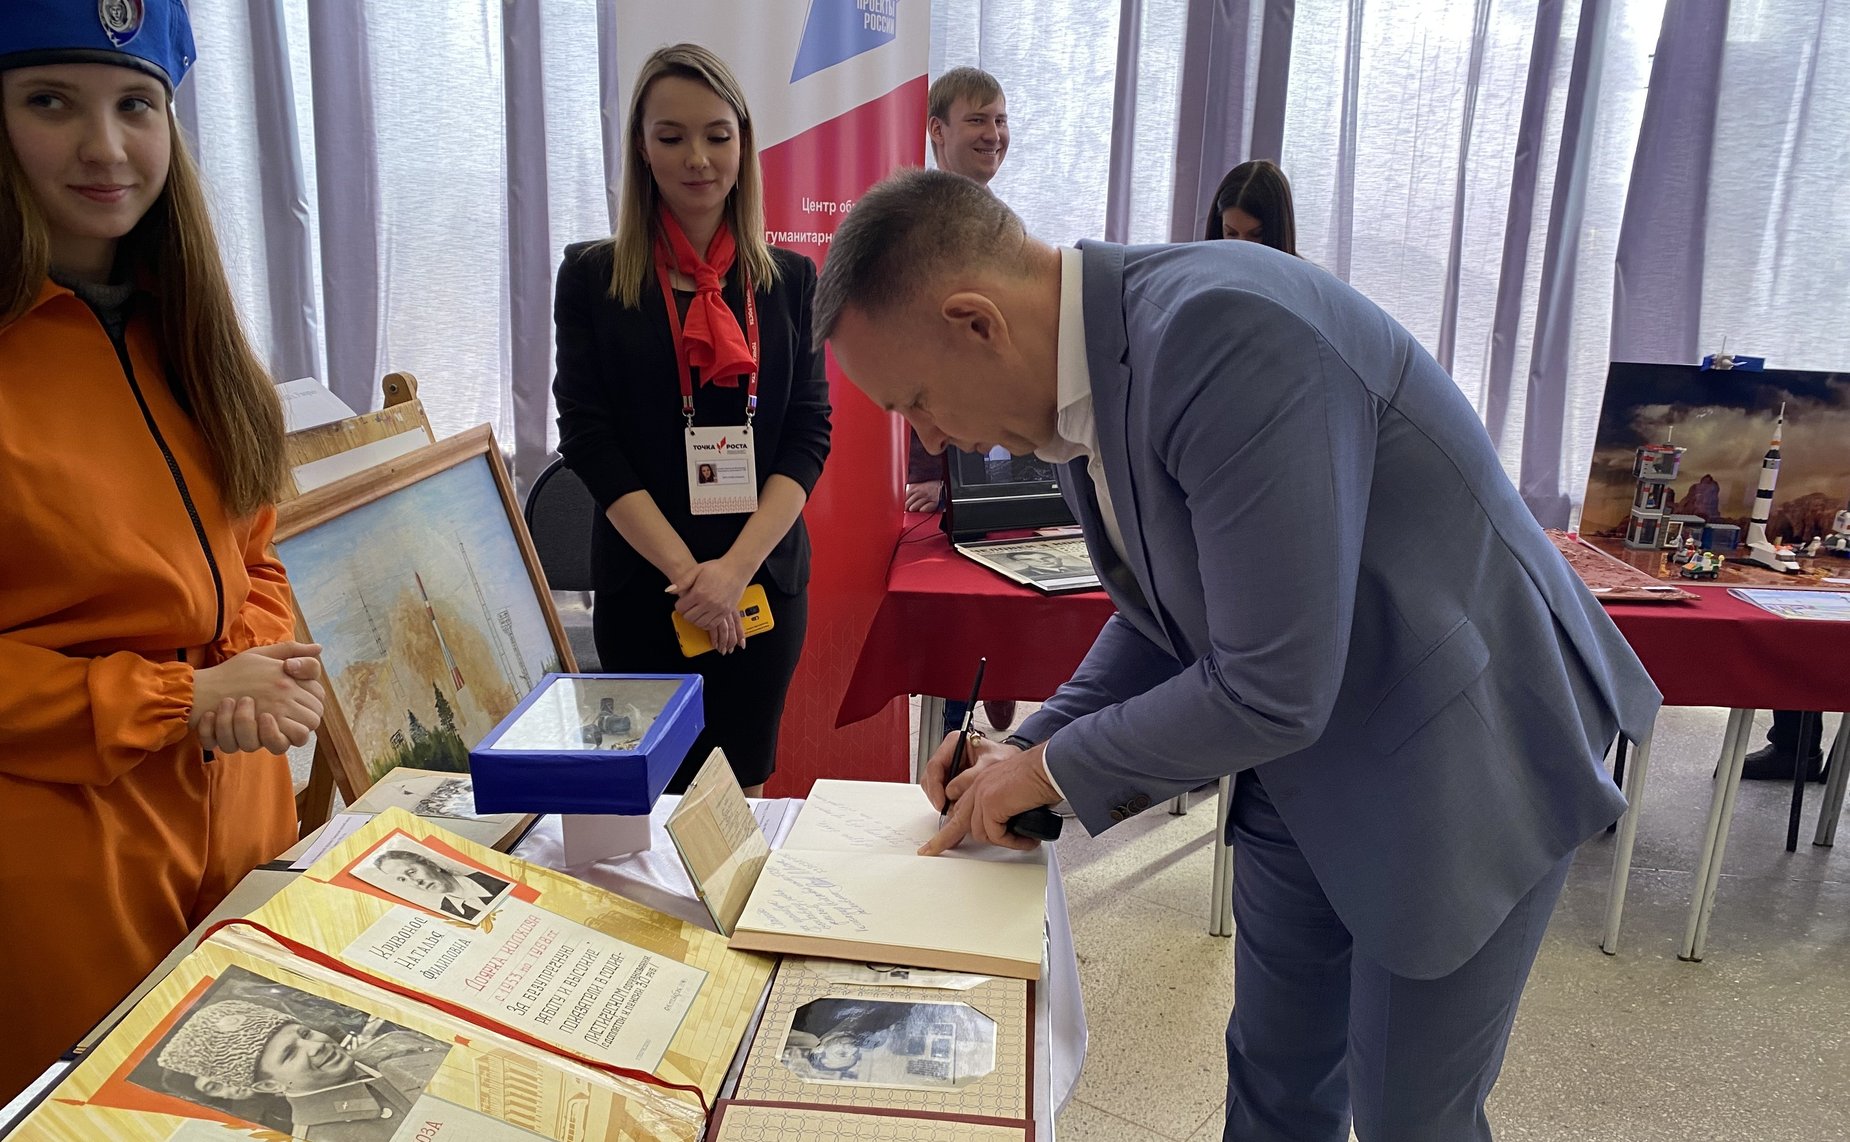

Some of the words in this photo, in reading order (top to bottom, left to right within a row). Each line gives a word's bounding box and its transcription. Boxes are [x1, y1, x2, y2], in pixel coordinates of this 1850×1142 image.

[864, 12, 895, 35] РОССИИ
[802, 197, 837, 216] Центр
[840, 200, 857, 213] об
[765, 230, 834, 246] гуманитарн
[499, 972, 523, 994] 1953
[635, 975, 651, 989] 30
